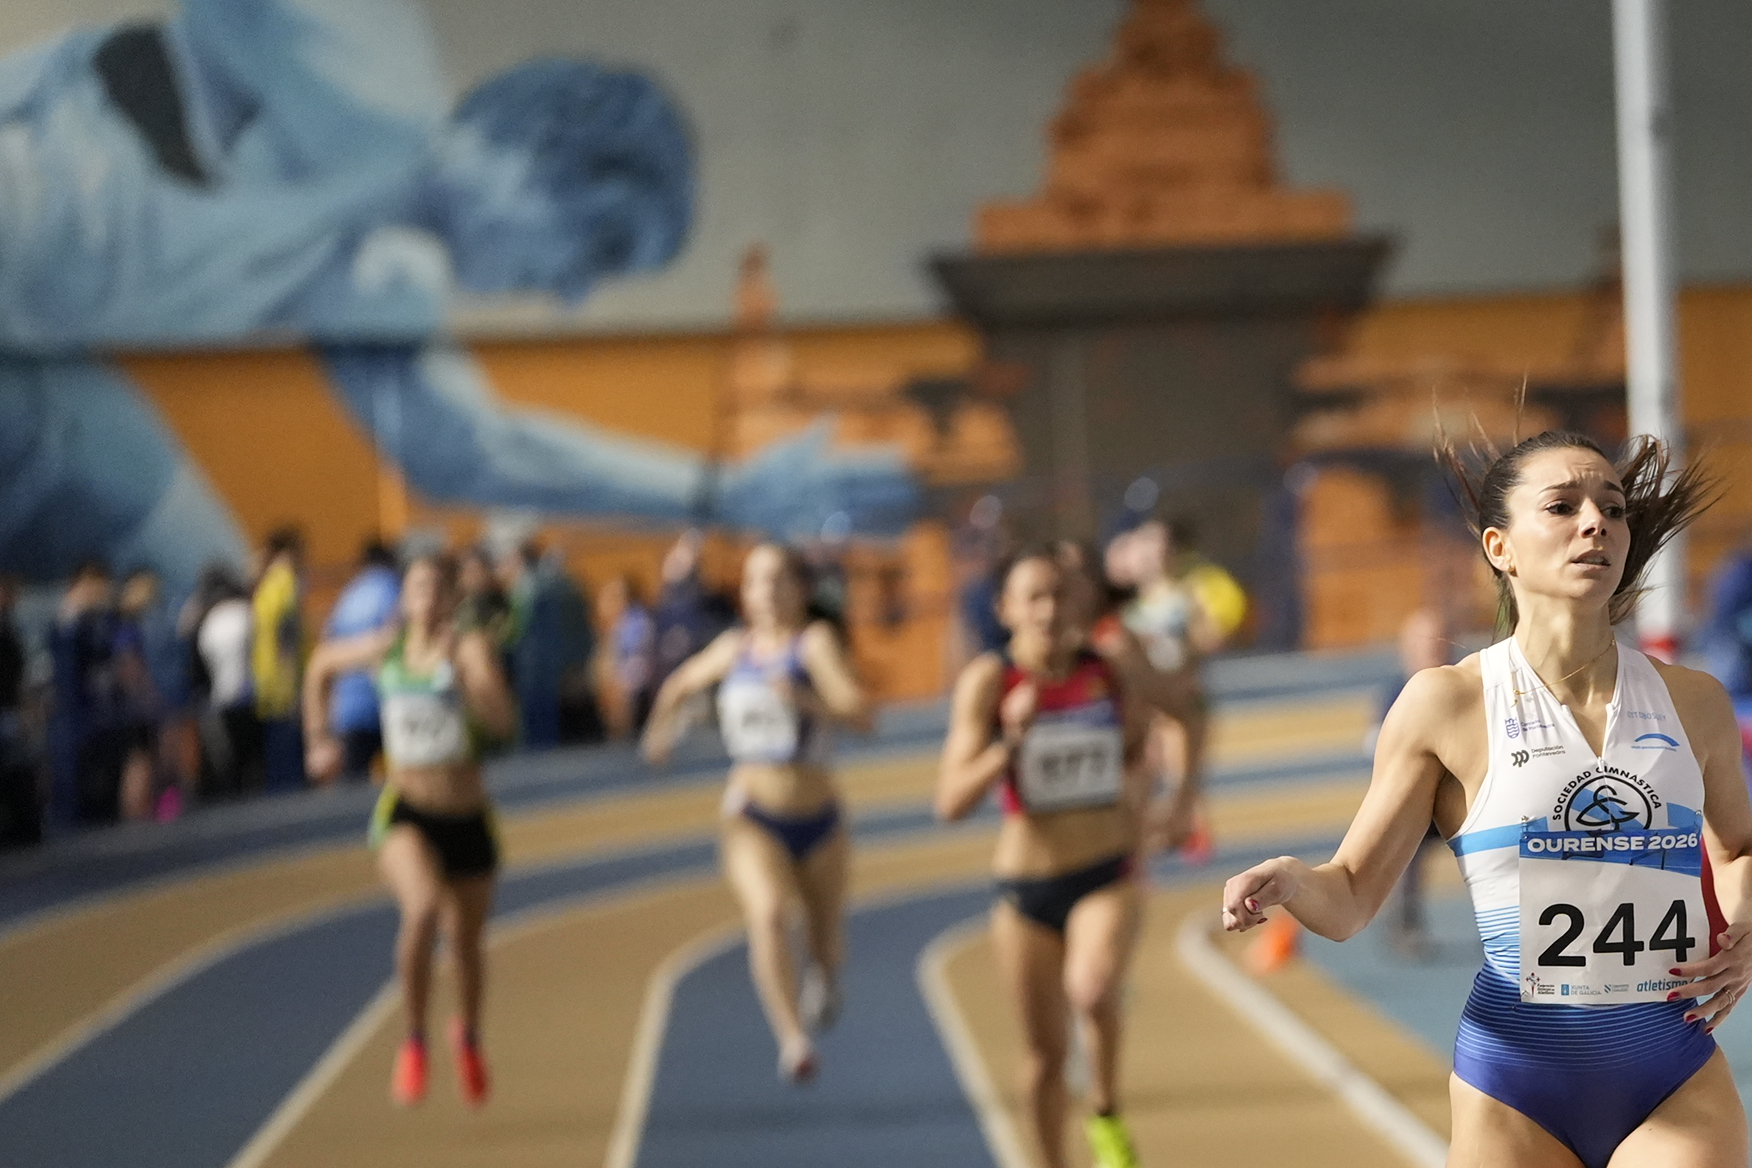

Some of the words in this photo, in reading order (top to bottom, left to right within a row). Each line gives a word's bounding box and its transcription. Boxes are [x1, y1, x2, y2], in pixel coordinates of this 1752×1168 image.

[1552, 770, 1592, 821] SOCIEDAD
[1527, 836, 1645, 853] OURENSE
[1648, 833, 1698, 850] 2026
[1538, 899, 1696, 967] 244
